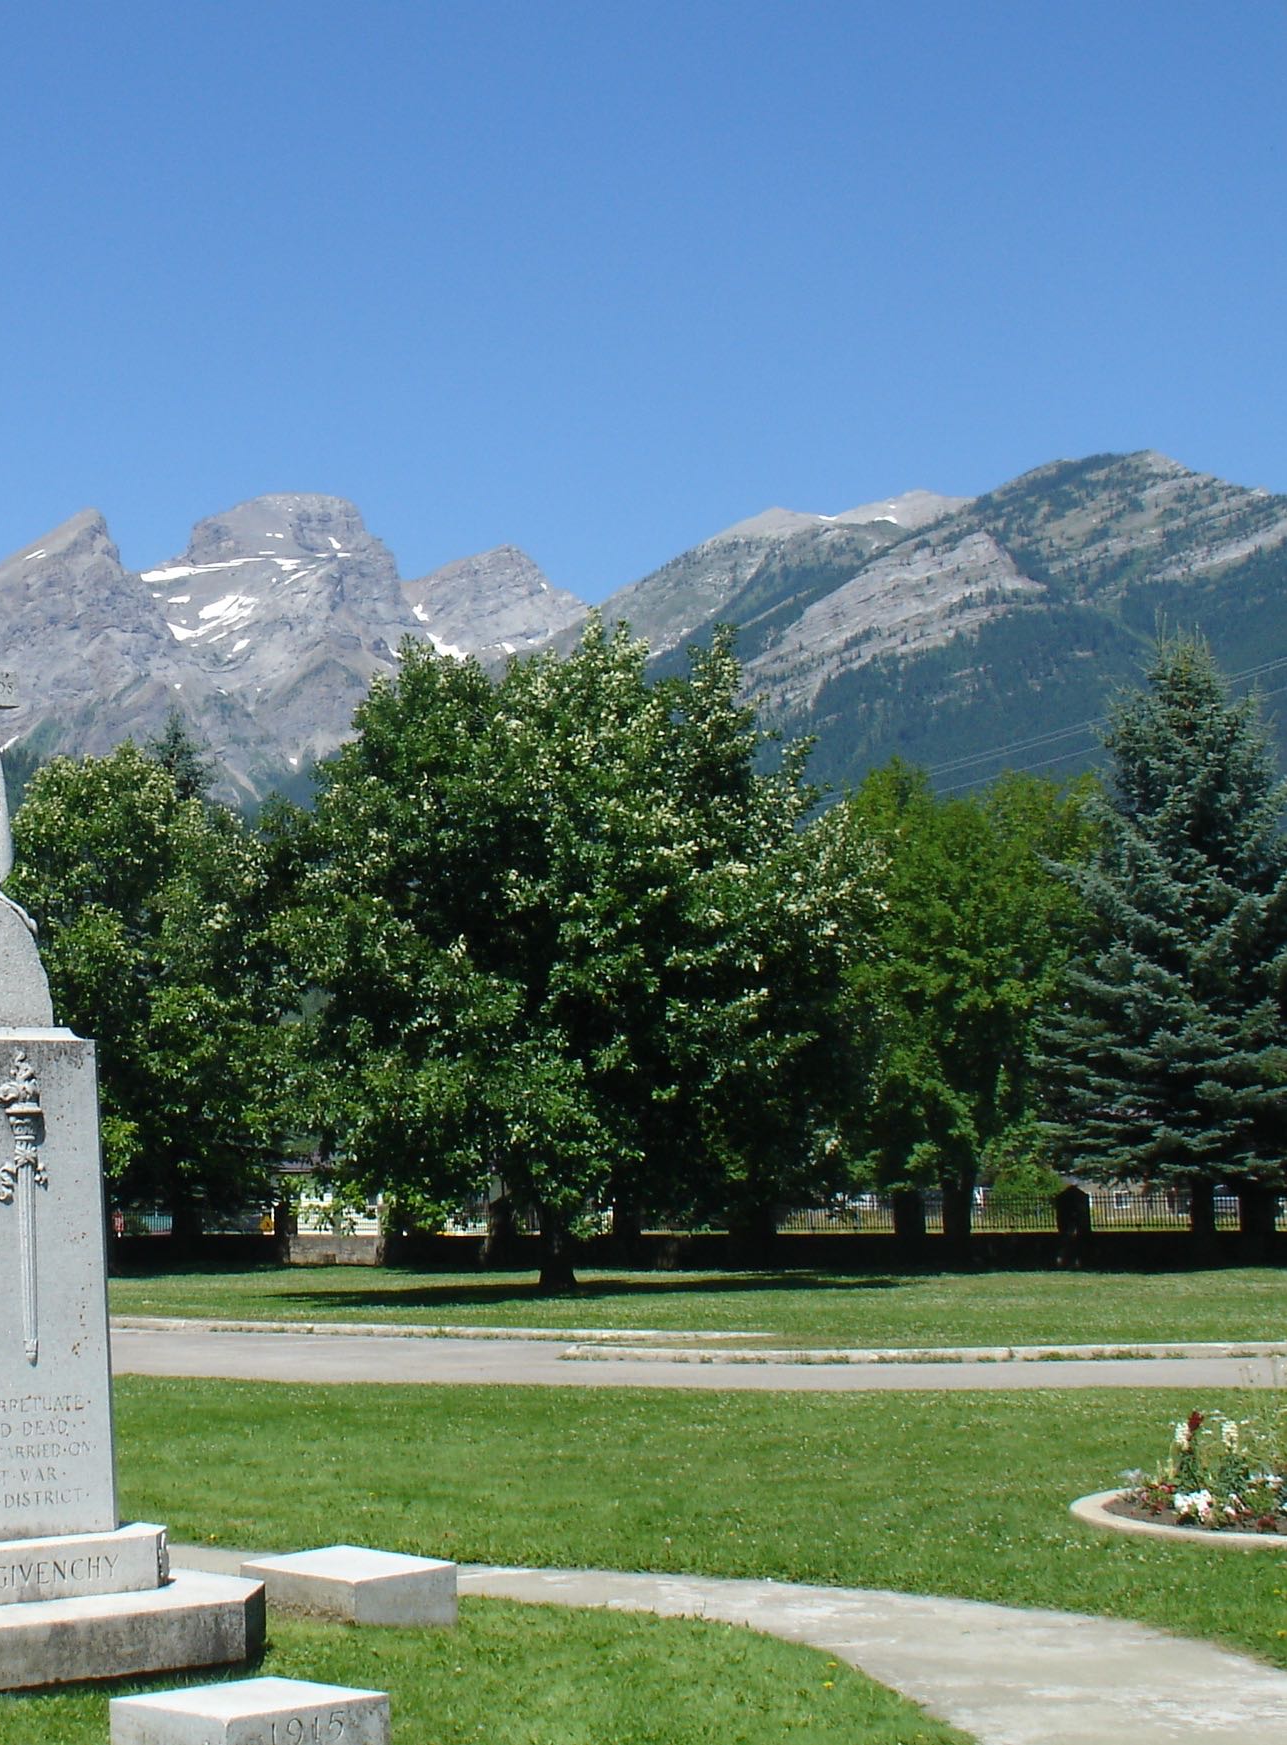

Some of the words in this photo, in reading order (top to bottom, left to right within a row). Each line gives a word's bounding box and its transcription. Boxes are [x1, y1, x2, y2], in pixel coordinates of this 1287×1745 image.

[68, 1440, 91, 1457] ON
[20, 1465, 58, 1482] WAR
[4, 1487, 83, 1510] DISTRICT
[271, 1709, 346, 1745] 1915
